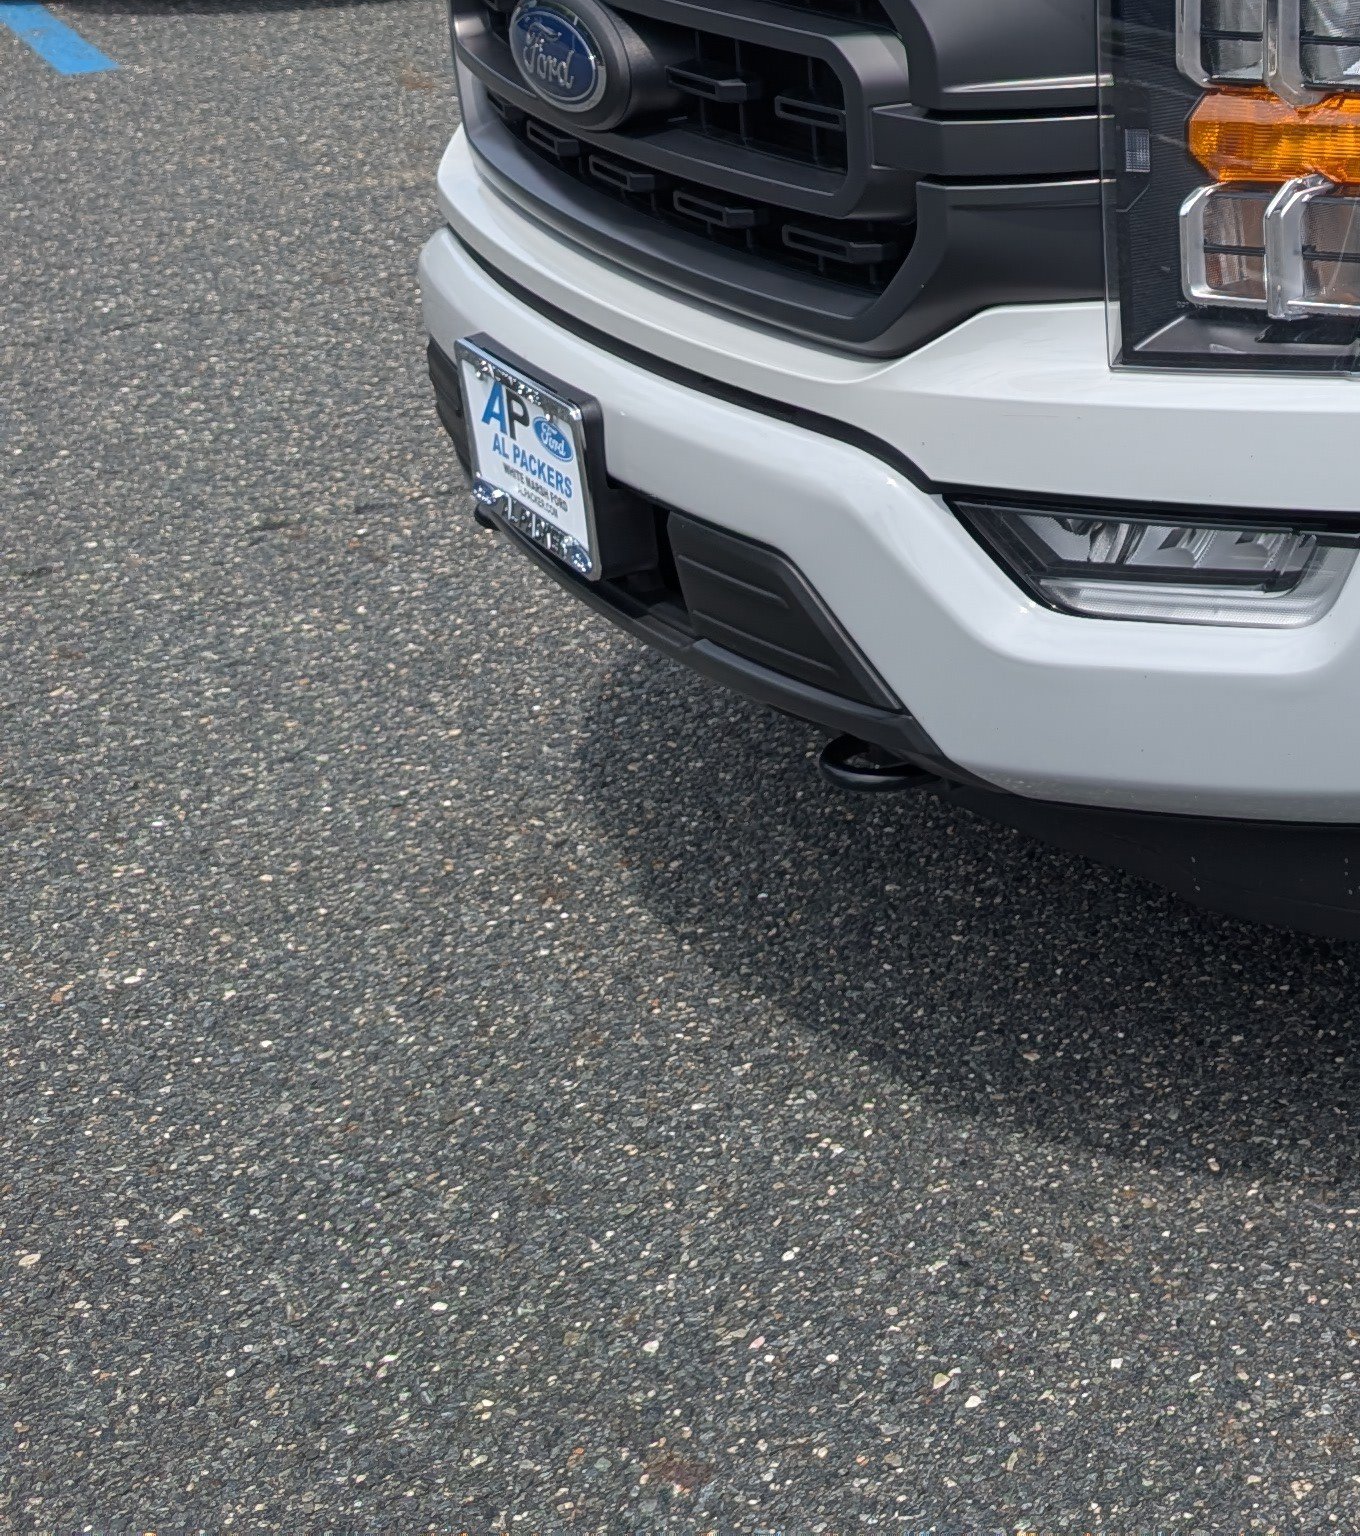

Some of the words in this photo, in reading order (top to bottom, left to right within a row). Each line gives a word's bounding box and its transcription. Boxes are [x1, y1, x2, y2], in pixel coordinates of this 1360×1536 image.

[523, 21, 576, 90] Ford
[481, 380, 531, 441] AP
[539, 420, 567, 457] Ford
[492, 433, 510, 460] AL
[512, 446, 573, 500] PACKERS
